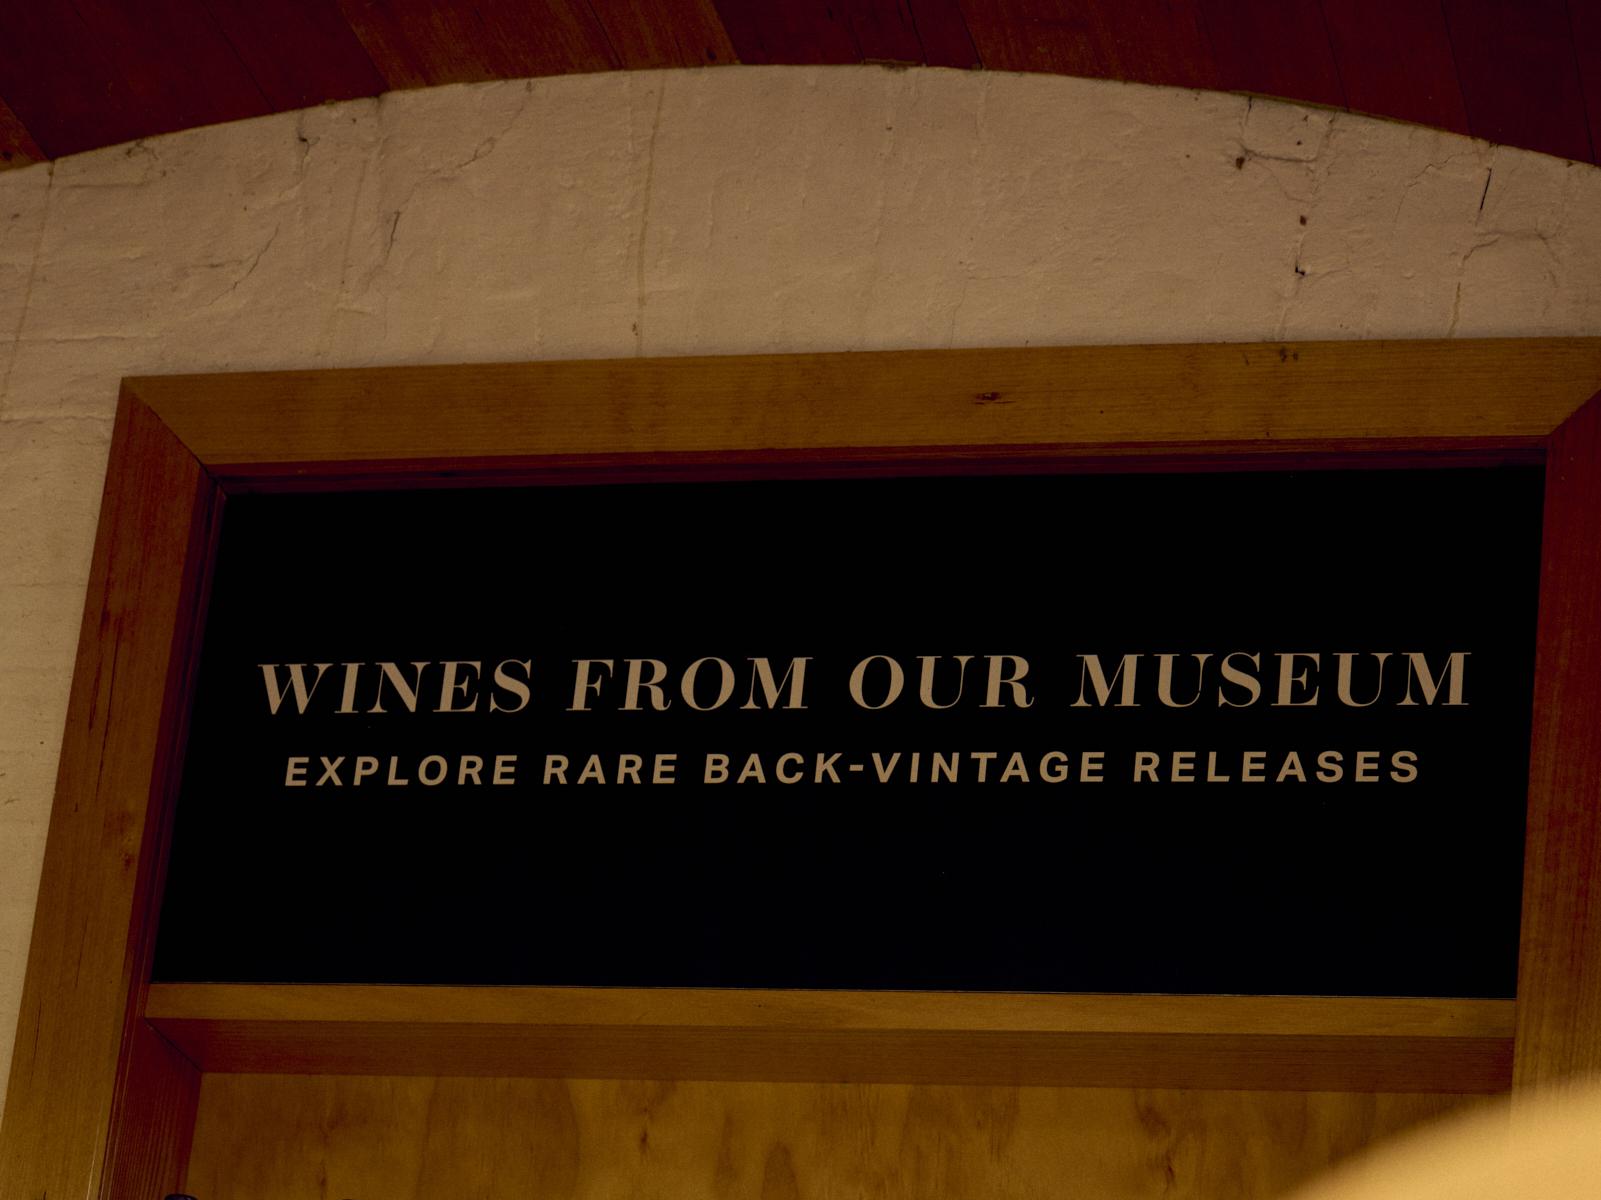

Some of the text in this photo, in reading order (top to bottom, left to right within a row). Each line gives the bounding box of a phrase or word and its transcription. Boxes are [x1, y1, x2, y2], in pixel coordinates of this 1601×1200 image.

[258, 652, 1472, 715] WINES FROM OUR MUSEUM
[284, 750, 1418, 787] EXPLORE RARE BACK-VINTAGE RELEASES
